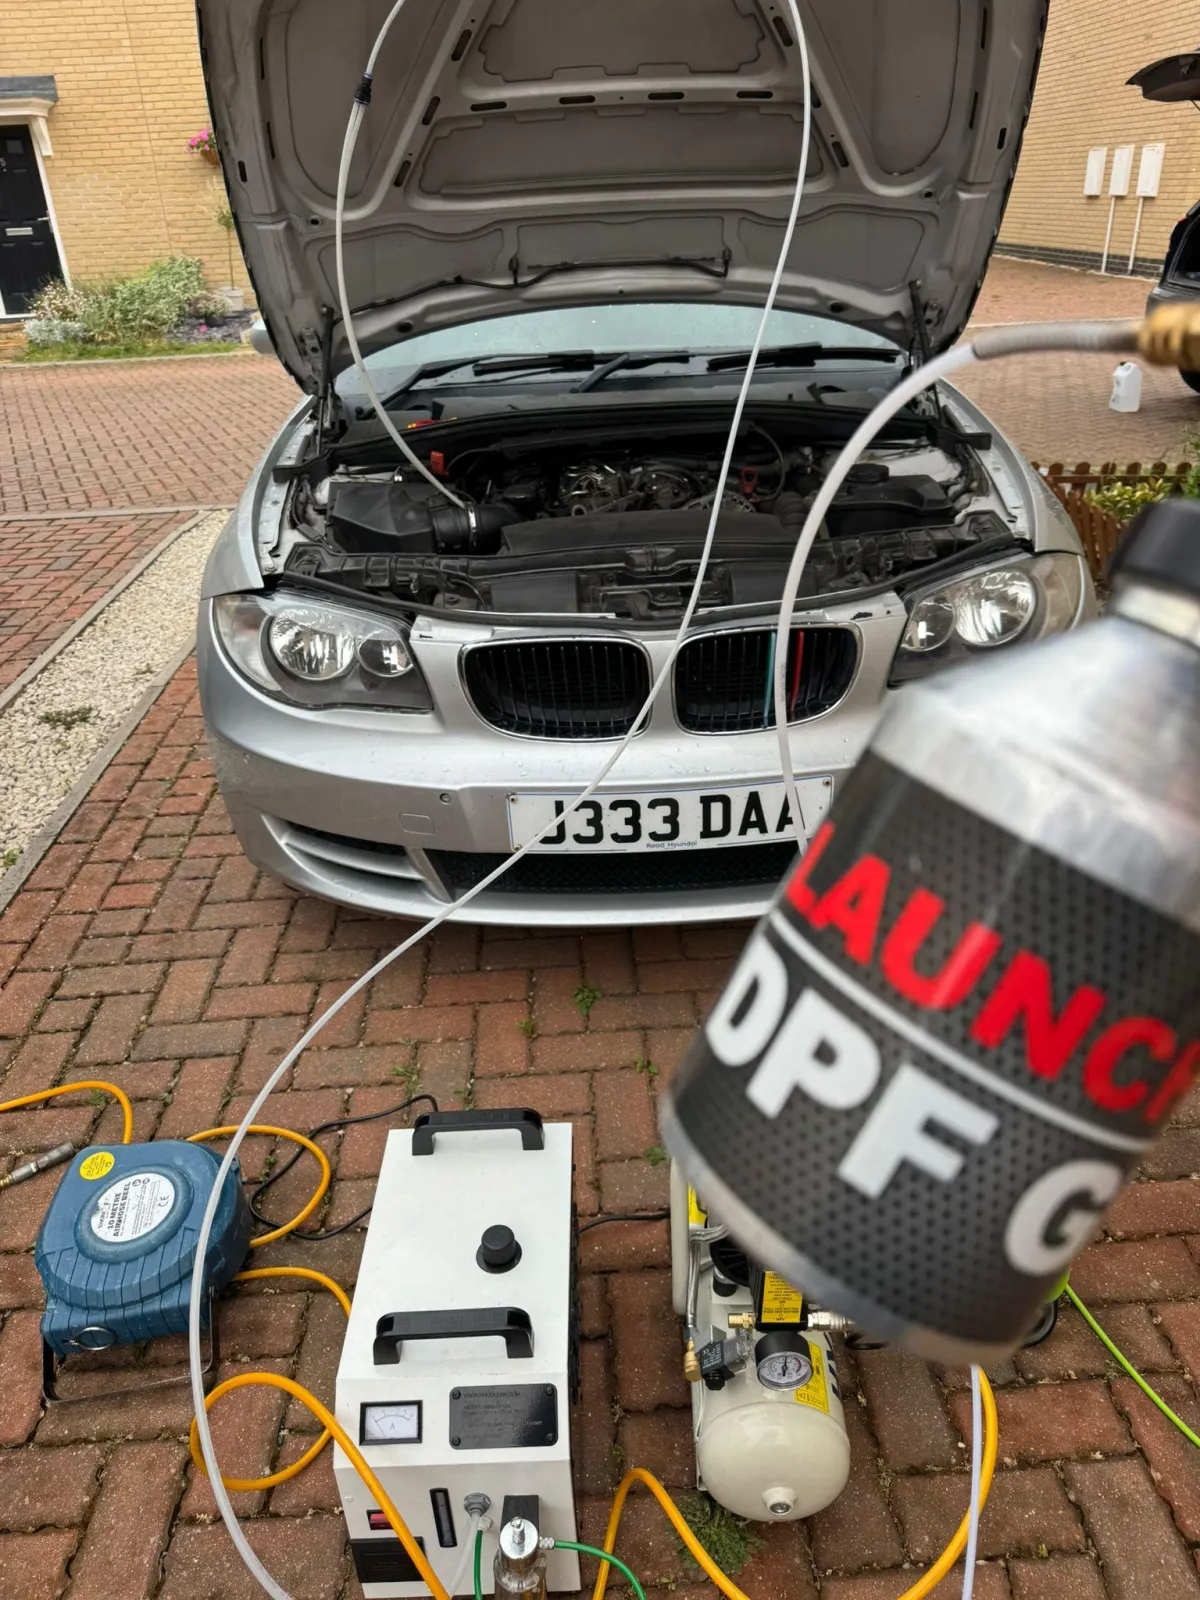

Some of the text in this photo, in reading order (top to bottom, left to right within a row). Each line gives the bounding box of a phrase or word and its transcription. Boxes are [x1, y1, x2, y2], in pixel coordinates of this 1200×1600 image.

[539, 797, 680, 844] J333
[667, 840, 698, 849] Hyundai
[705, 932, 999, 1199] DPF
[121, 1181, 131, 1201] REEL
[107, 1192, 122, 1229] 10 METRE
